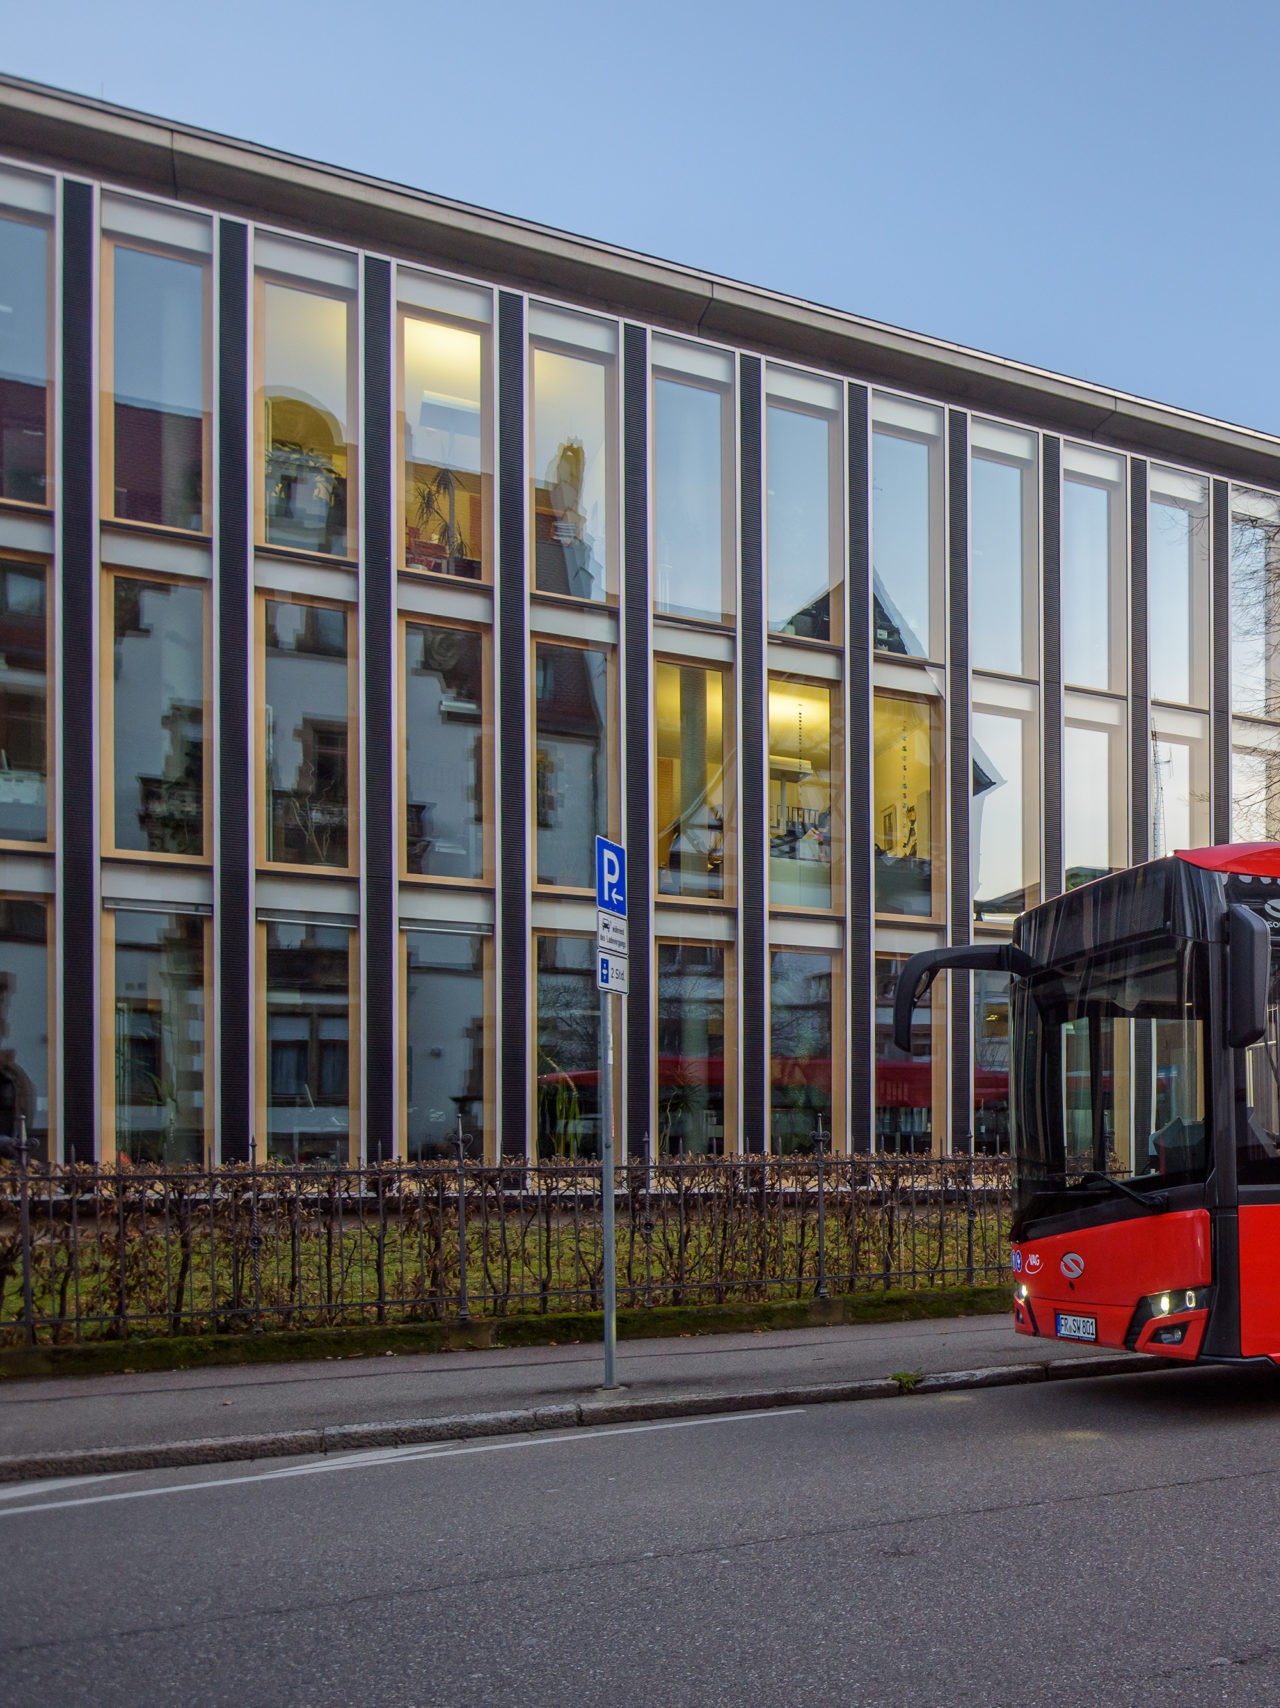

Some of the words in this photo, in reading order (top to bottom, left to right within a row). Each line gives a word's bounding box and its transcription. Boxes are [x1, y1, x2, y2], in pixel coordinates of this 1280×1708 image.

[603, 849, 619, 901] P
[611, 967, 615, 978] 2
[1028, 1254, 1039, 1266] VAG
[1060, 1317, 1068, 1332] FR
[1072, 1318, 1081, 1333] SW
[1082, 1320, 1094, 1336] 801
